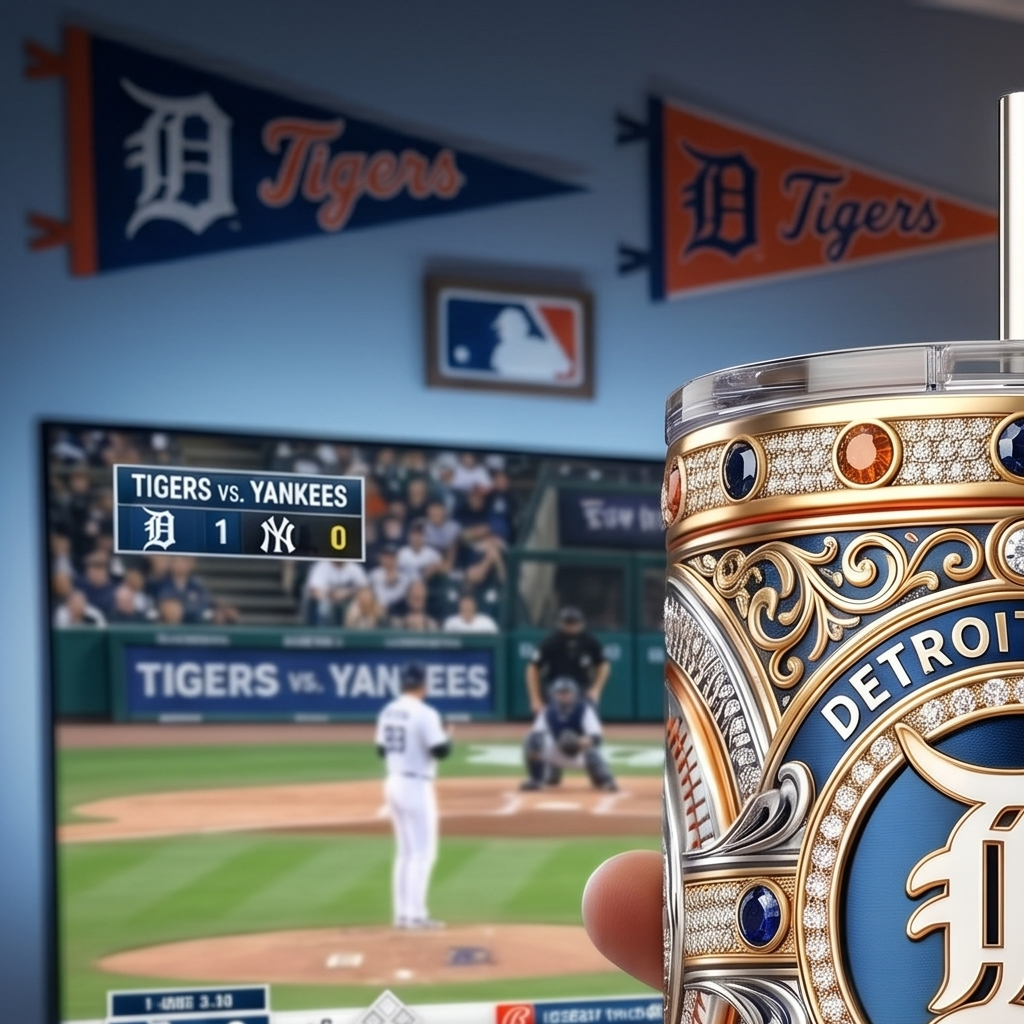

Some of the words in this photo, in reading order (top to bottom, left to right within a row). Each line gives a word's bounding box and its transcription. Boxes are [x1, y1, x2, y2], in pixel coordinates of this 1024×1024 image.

[257, 116, 467, 233] Tigers
[779, 169, 942, 263] Tigers
[131, 473, 212, 501] TIGERS
[250, 480, 348, 508] YANKEES
[214, 518, 228, 545] 1
[330, 525, 347, 550] 0
[135, 662, 281, 699] TIGERS
[328, 664, 490, 699] YANEES
